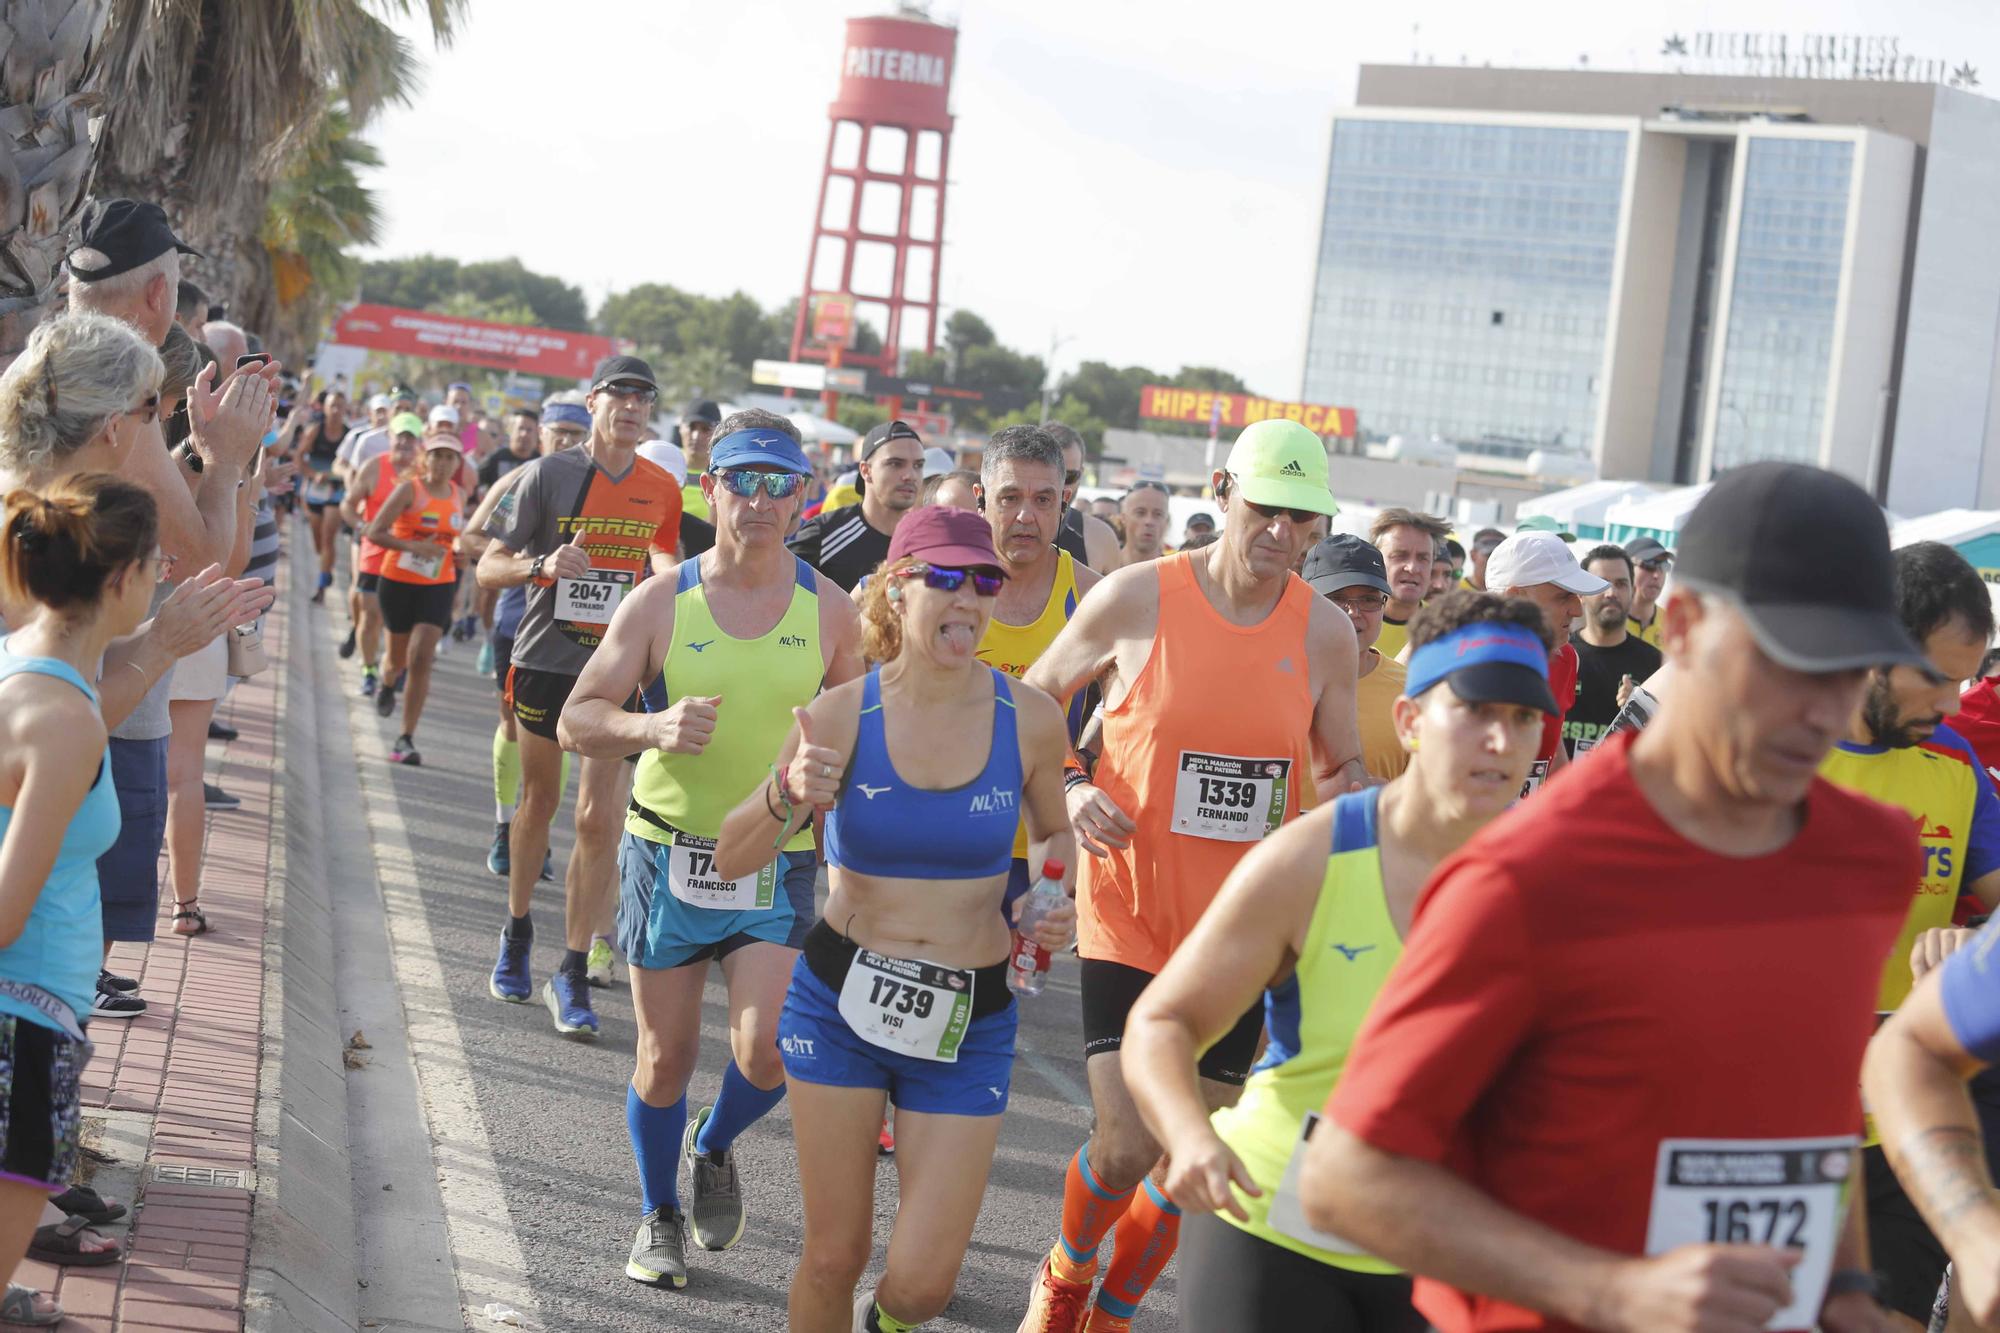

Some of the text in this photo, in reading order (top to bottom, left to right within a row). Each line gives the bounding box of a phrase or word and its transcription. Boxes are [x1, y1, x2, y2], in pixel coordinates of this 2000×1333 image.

[846, 46, 944, 86] PATERNA
[1151, 389, 1342, 435] HIPER MERCA
[1279, 469, 1306, 478] adidas
[568, 582, 613, 602] 2047
[571, 601, 605, 611] FERNANDO
[577, 636, 601, 646] ALD
[1189, 757, 1242, 769] MEDIA MARATÓN
[1205, 764, 1214, 772] DE
[1214, 766, 1242, 775] PATERNA
[1199, 777, 1257, 809] 1339
[1275, 788, 1283, 806] BOX
[1197, 807, 1249, 822] FERNANDO
[681, 837, 694, 845] VILA
[687, 878, 737, 892] FRANCISCO
[865, 956, 880, 967] VILA
[882, 961, 892, 970] DE
[892, 964, 921, 980] PATERNA
[888, 957, 922, 973] MARATÓN
[869, 975, 935, 1019] 1739
[882, 1013, 904, 1029] VISI
[955, 1004, 967, 1024] BOX
[1703, 1200, 1807, 1248] 1672
